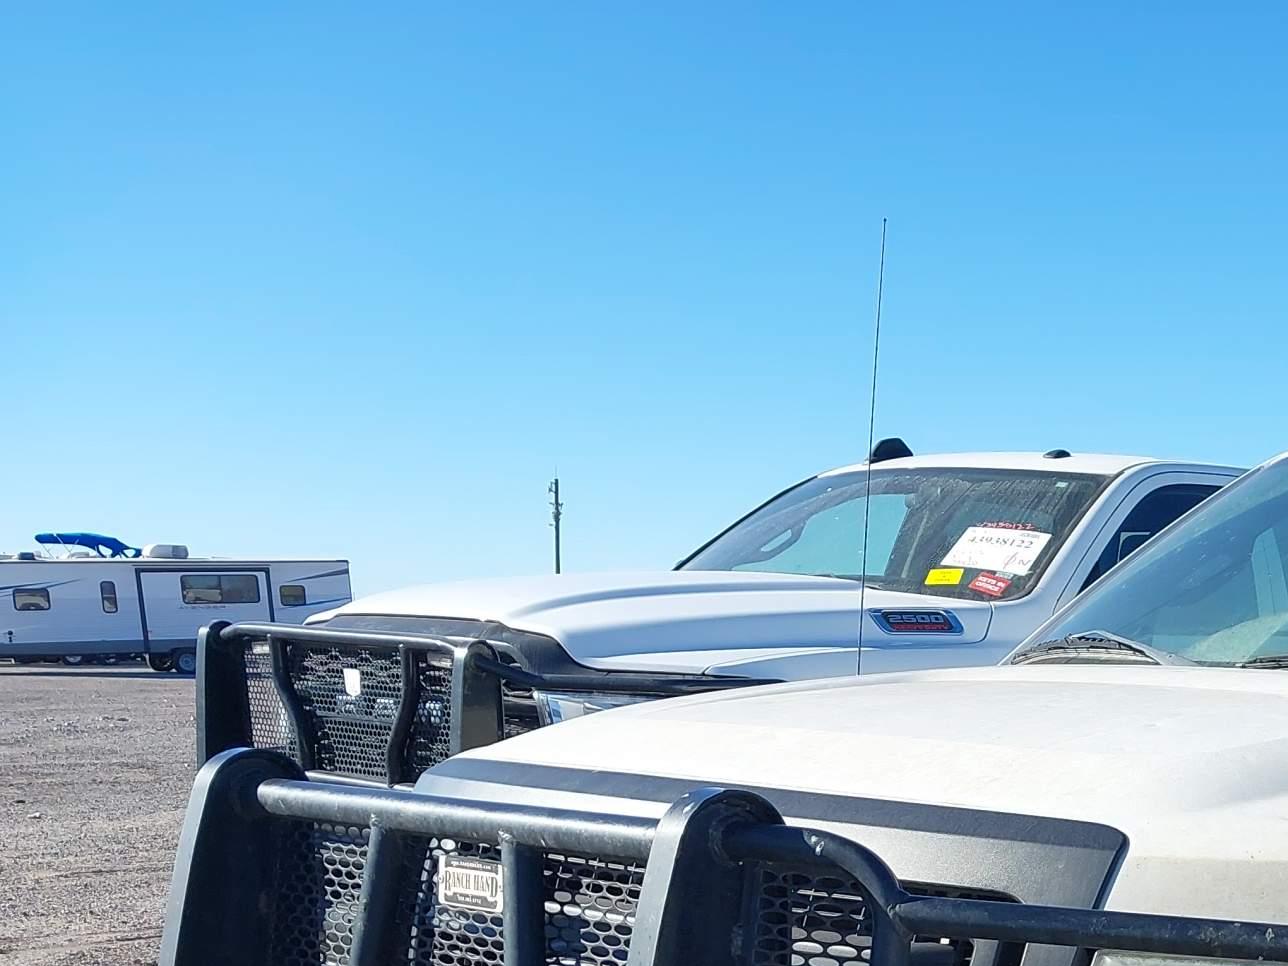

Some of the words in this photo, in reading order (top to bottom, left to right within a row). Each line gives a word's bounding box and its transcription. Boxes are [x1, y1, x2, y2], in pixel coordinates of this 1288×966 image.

[888, 614, 944, 623] 2500
[445, 871, 471, 891] RANCH
[474, 875, 497, 896] HAND
